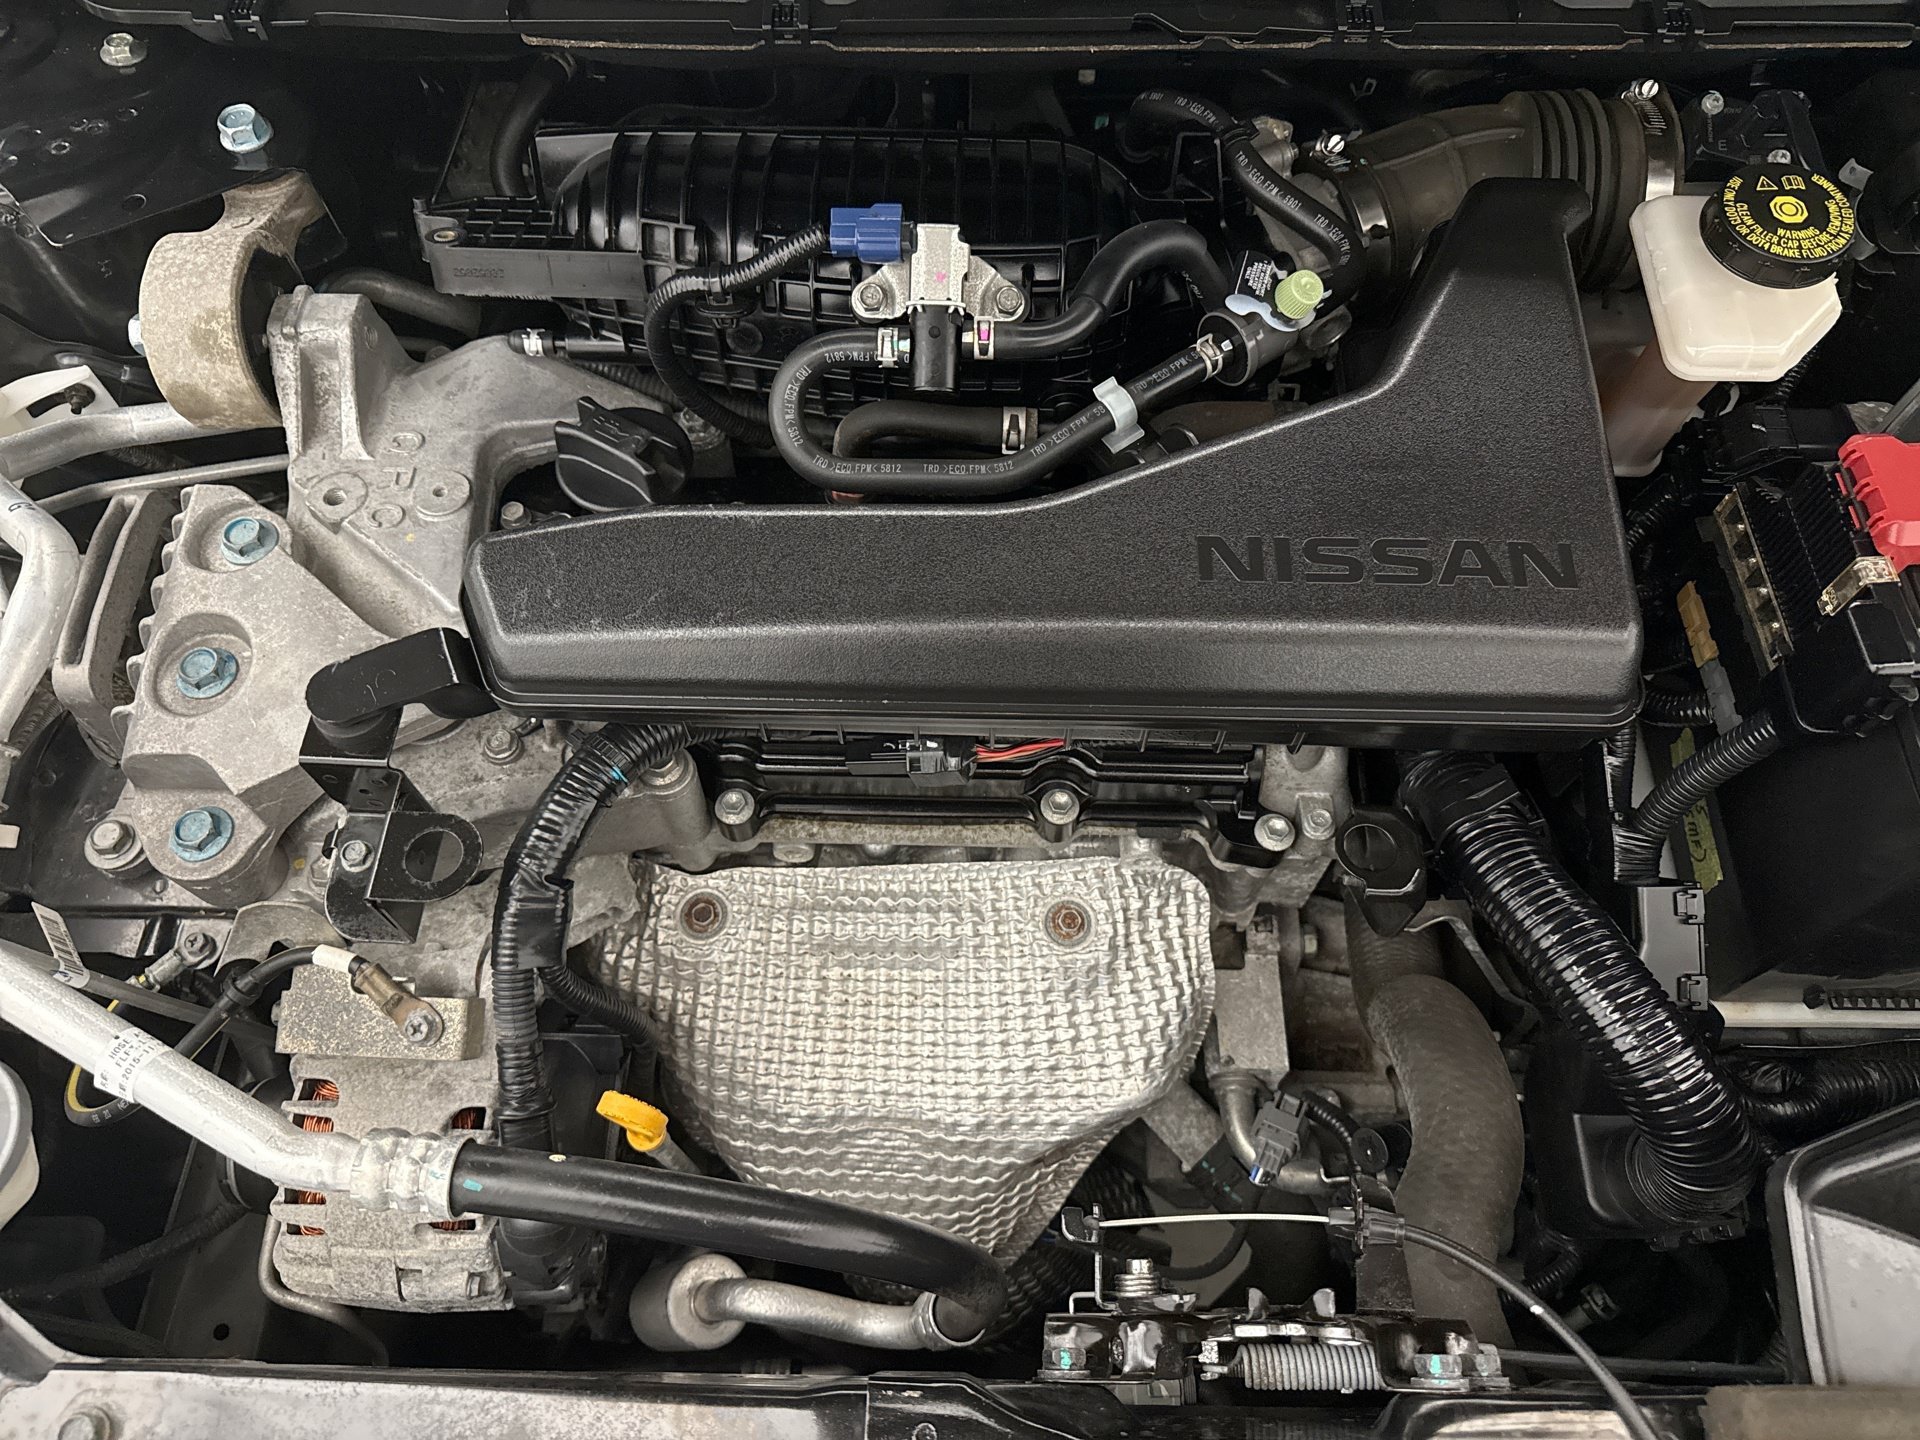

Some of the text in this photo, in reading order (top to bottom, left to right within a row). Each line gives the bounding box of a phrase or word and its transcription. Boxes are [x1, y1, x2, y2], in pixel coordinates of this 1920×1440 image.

[1726, 176, 1744, 190] USE
[1811, 173, 1850, 207] CONTAINER
[1283, 195, 1302, 211] 5901
[1723, 188, 1736, 206] ONLY
[1736, 199, 1842, 249] CLEAN FILLER CAP BEFORE REMOVING
[1841, 208, 1855, 233] SEALED
[1736, 224, 1750, 236] OR
[1777, 226, 1820, 240] WARNING
[1839, 232, 1851, 240] A
[1746, 233, 1771, 251] DOT4
[1824, 235, 1848, 254] FROM
[1770, 244, 1801, 258] BRAKE
[1802, 247, 1827, 258] FLUID
[824, 351, 845, 364] 5812
[796, 365, 812, 381] TRD
[788, 427, 804, 447] 5812
[1030, 442, 1047, 457] TRD
[812, 454, 829, 469] TRD
[881, 464, 901, 473] 5812
[923, 463, 939, 473] TRD
[994, 460, 1014, 472] 5812
[1197, 534, 1579, 591] NISSAN
[108, 1038, 132, 1059] HOSE
